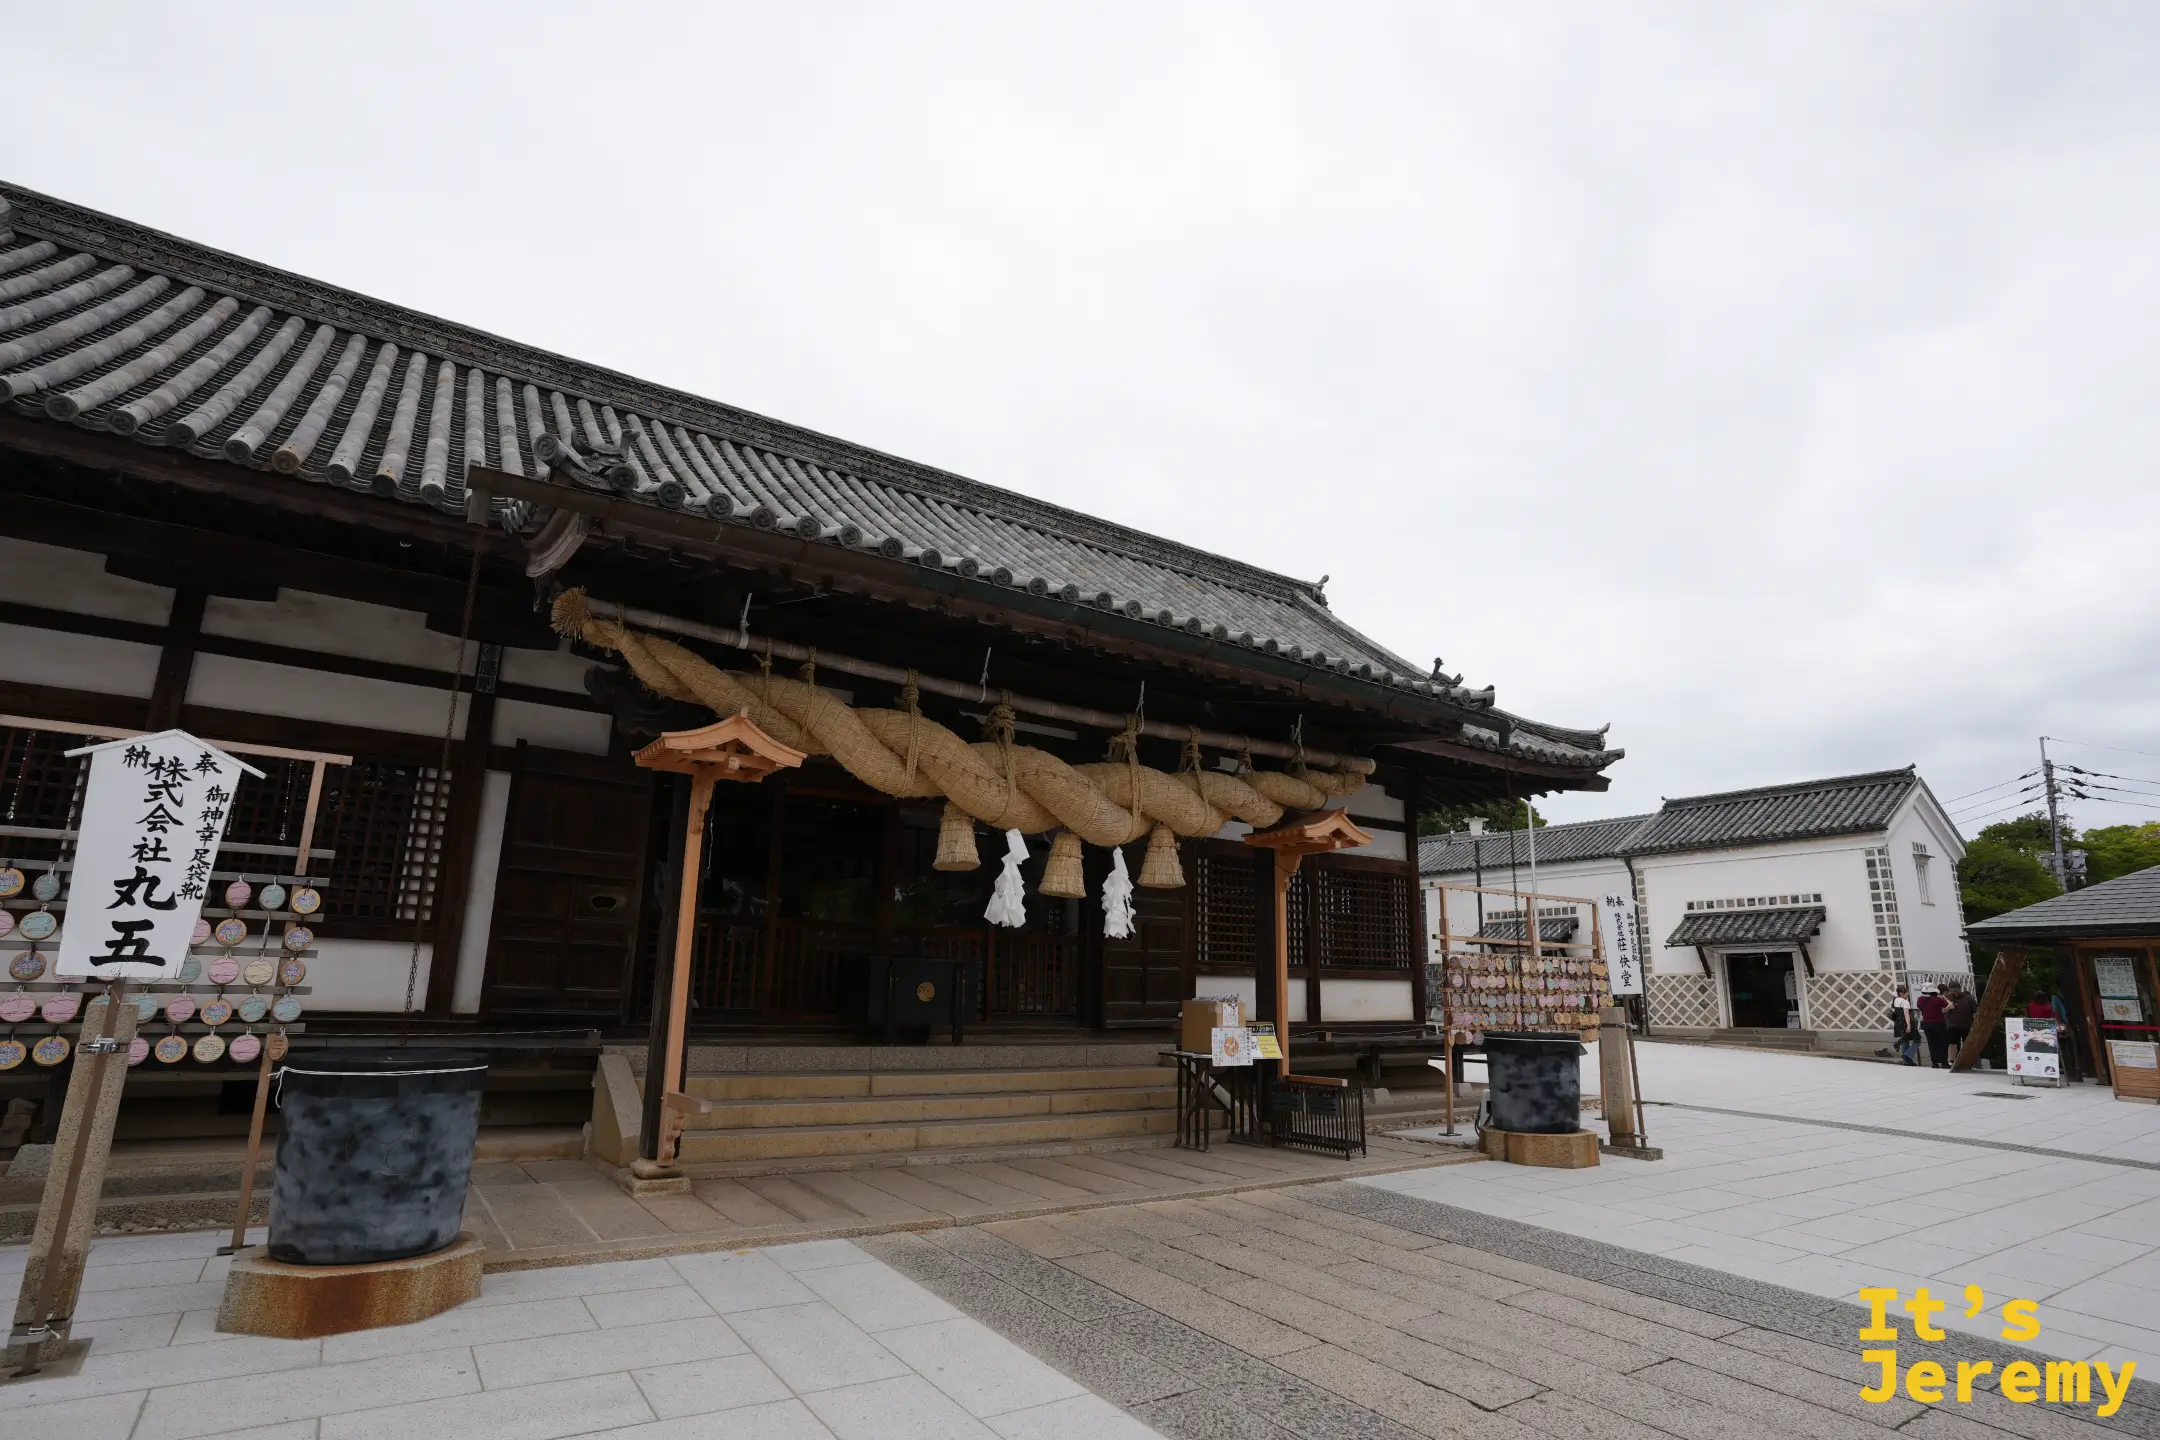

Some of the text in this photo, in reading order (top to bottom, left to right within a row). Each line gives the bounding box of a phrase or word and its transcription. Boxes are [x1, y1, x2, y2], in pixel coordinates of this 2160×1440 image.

[90, 755, 194, 967] 株式会社丸五
